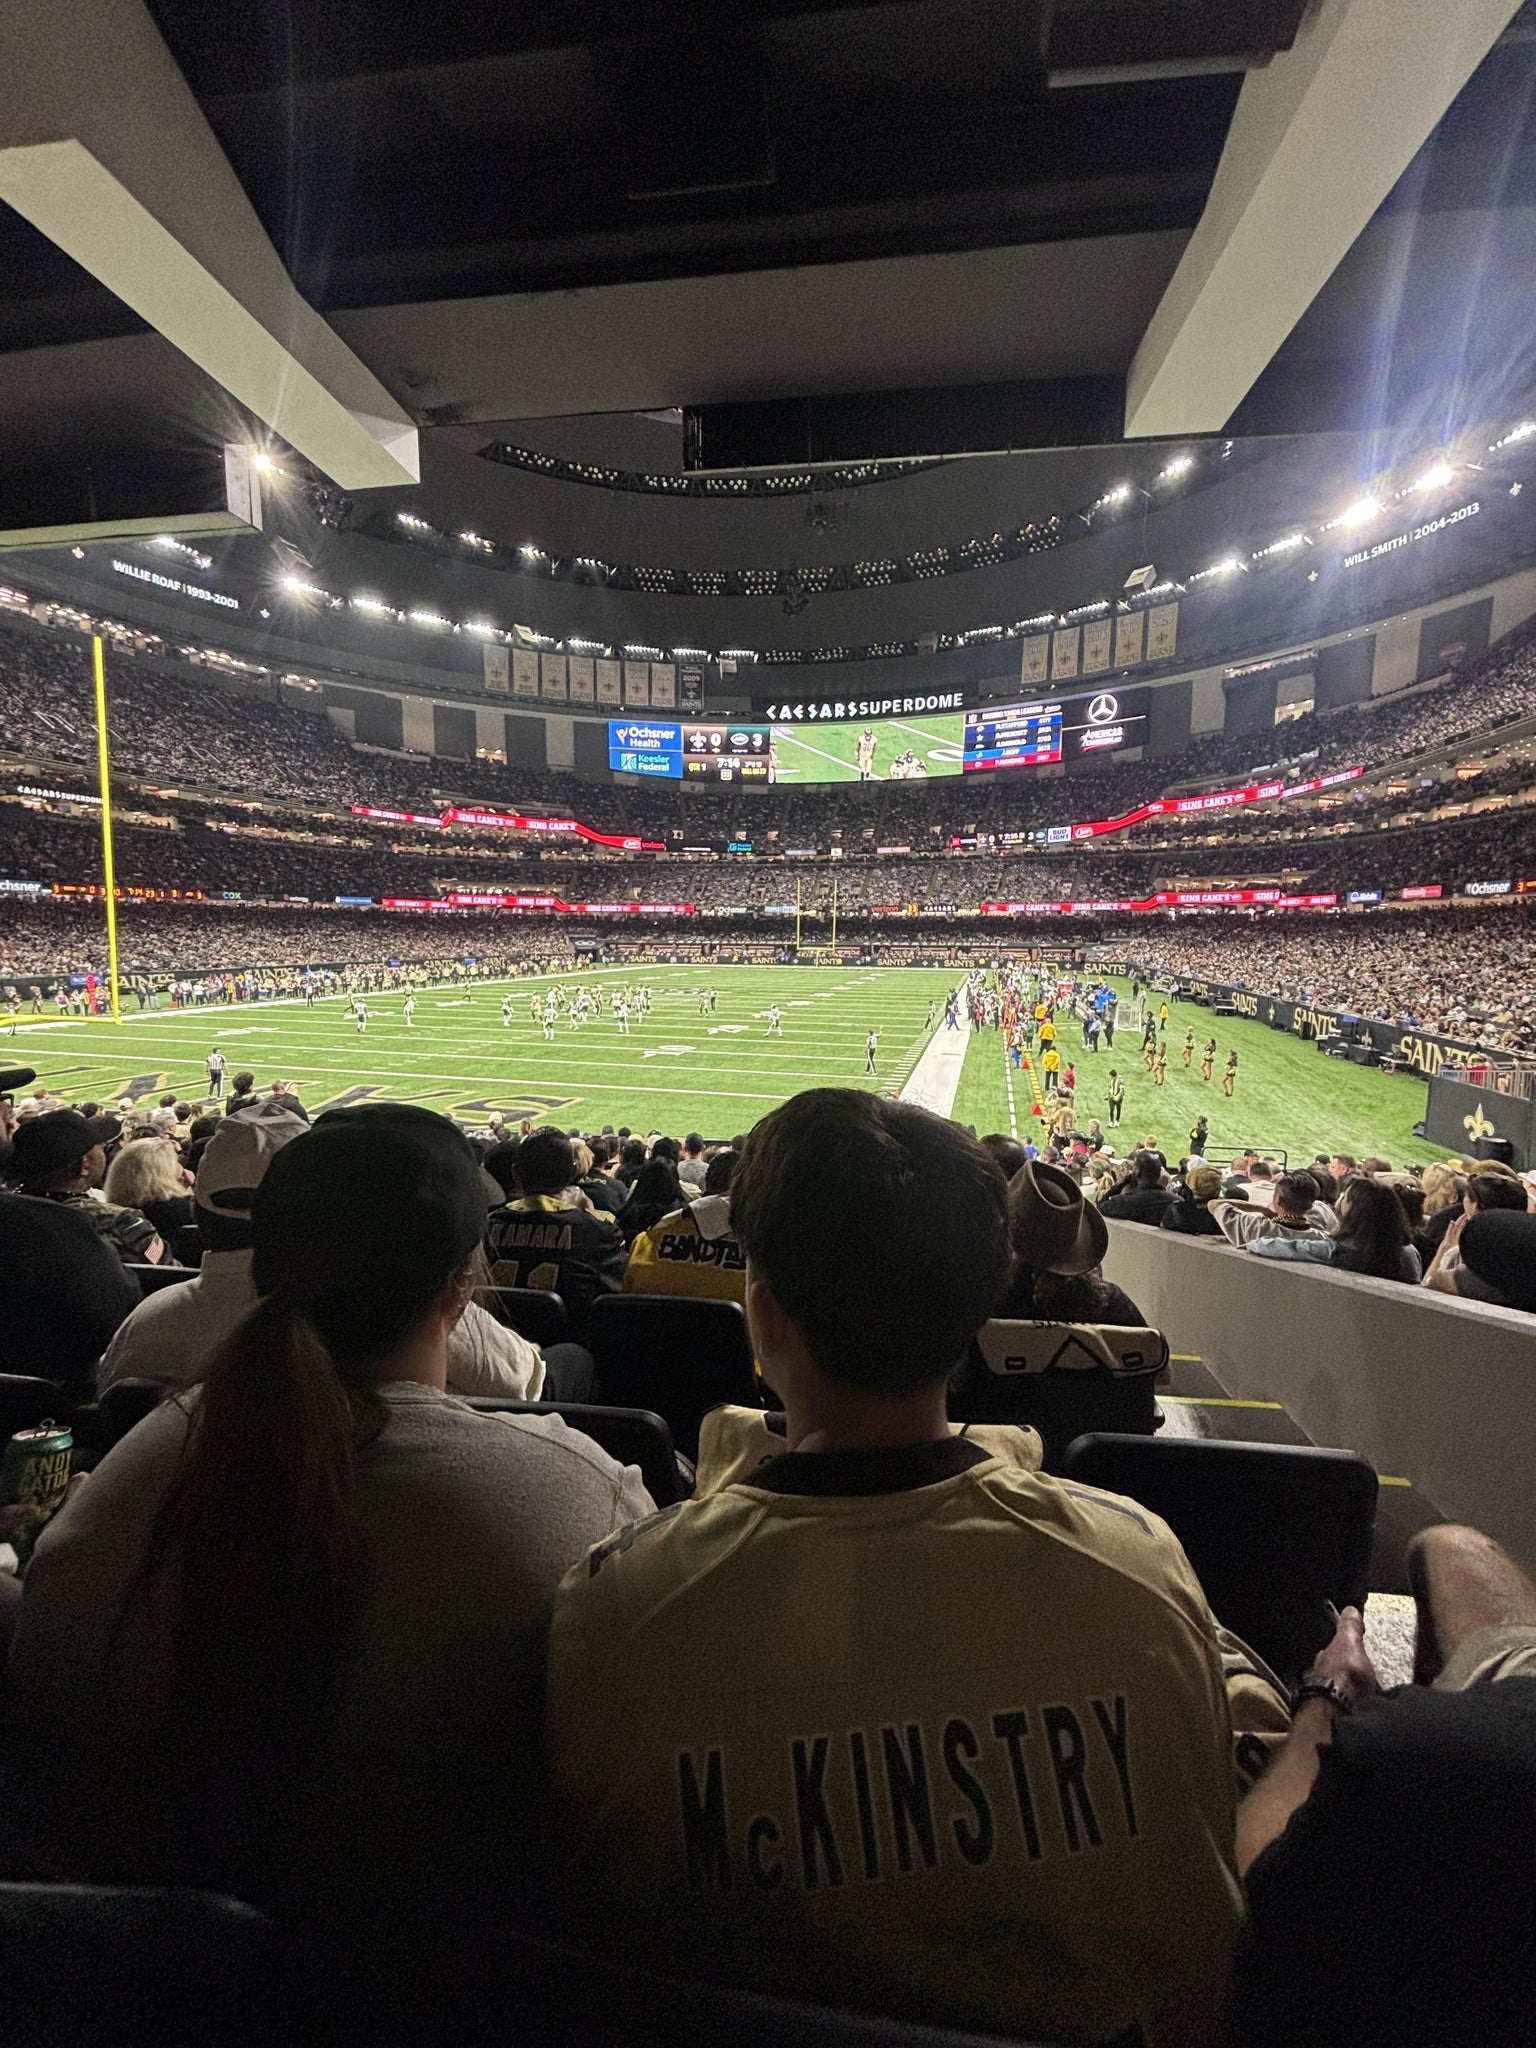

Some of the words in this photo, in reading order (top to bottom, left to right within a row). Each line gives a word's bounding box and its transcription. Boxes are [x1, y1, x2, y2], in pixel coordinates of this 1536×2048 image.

[1344, 548, 1370, 568] WILL
[1371, 534, 1408, 558] SMITH
[1414, 502, 1480, 540] 2004-2013
[112, 559, 151, 582] WILLIE
[152, 573, 181, 592] ROAF
[187, 584, 239, 610] 1993-2001
[766, 702, 858, 722] CAESARS
[859, 692, 964, 716] SUPERDOME
[629, 726, 675, 739] Ochsner
[630, 738, 661, 748] Health
[710, 733, 721, 746] 0
[752, 733, 763, 747] 3
[638, 754, 670, 765] Keesler
[638, 762, 670, 772] Federal
[61, 791, 104, 804] SUPERDOM
[1049, 833, 1070, 841] LIGHT
[1052, 828, 1067, 836] BUD
[641, 841, 665, 849] verizon
[1471, 882, 1511, 895] Ochsner
[718, 905, 747, 914] Ochsner
[871, 905, 899, 913] verizon
[630, 955, 657, 963] SAINTS
[877, 959, 906, 967] SAINTS
[944, 959, 975, 968] SAINTS
[1084, 963, 1126, 975] SAINTS
[675, 1692, 1139, 1894] McKINSTRY
